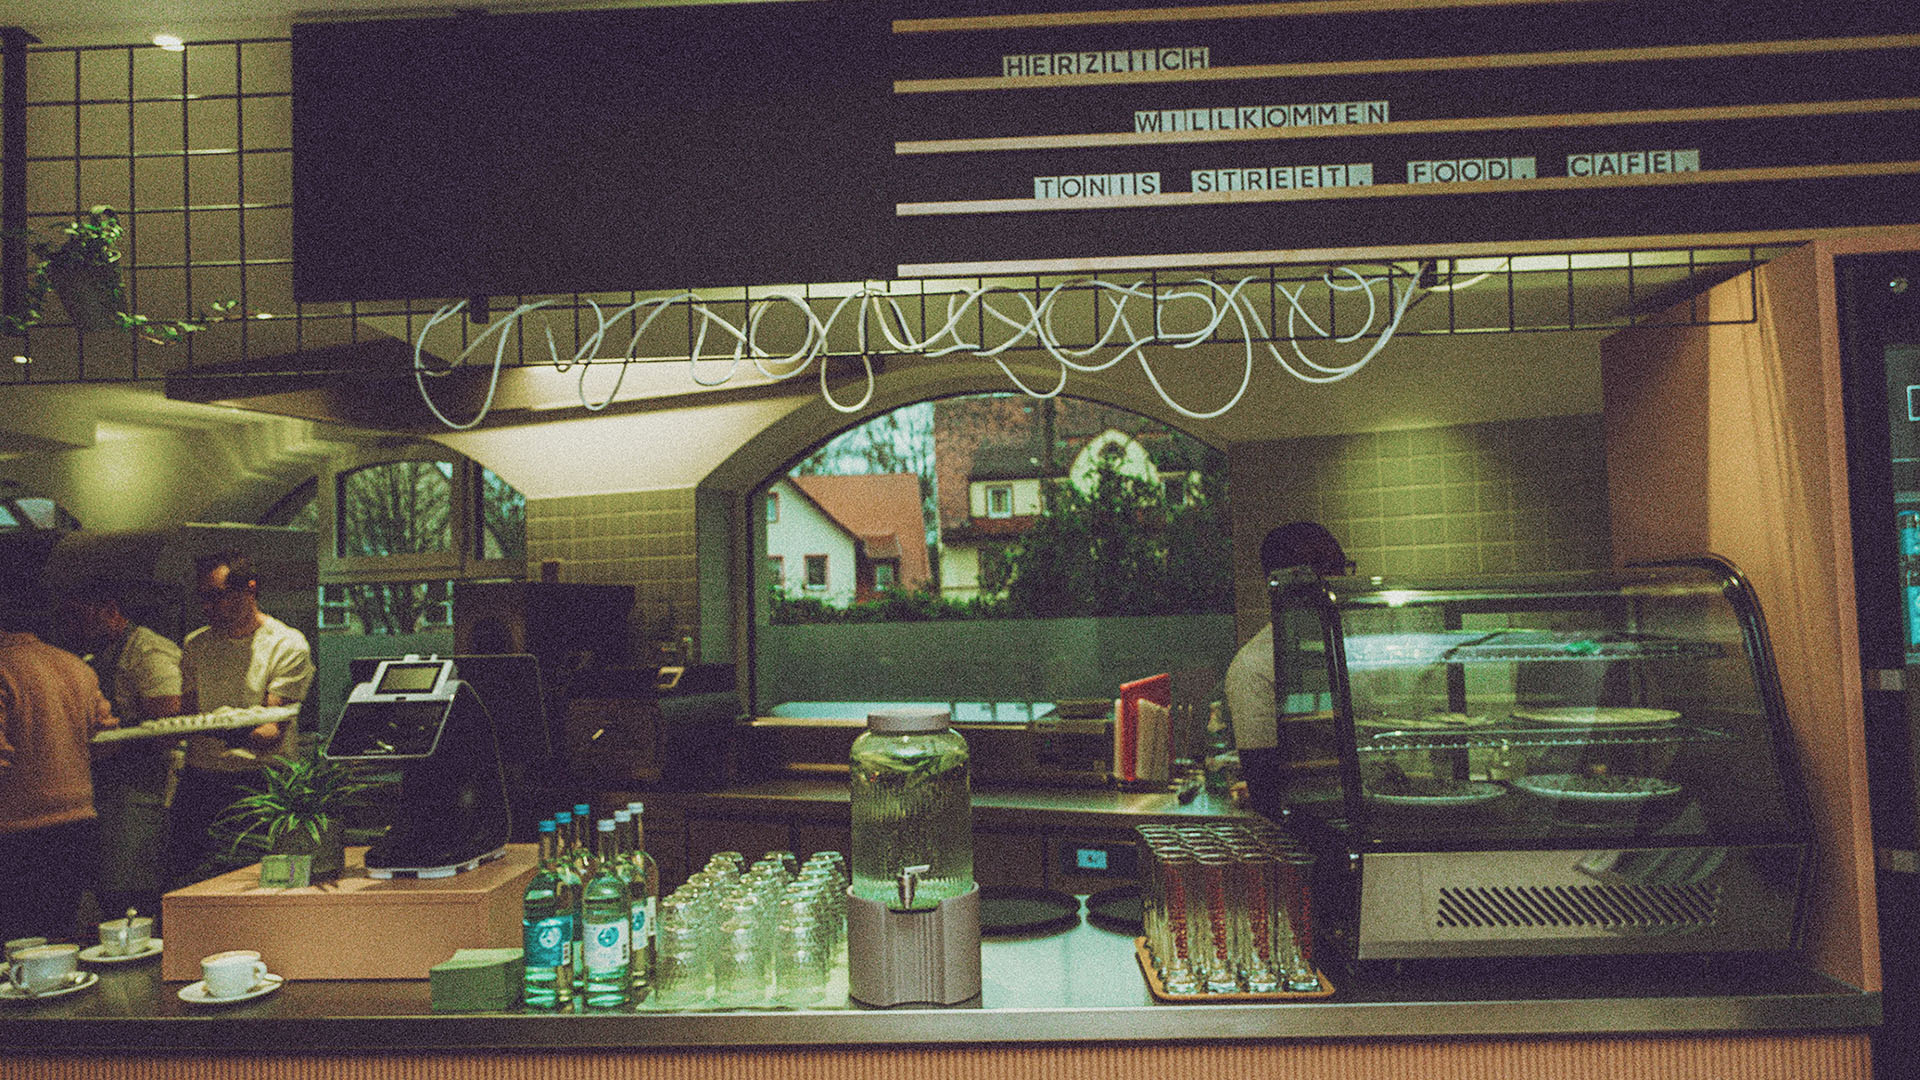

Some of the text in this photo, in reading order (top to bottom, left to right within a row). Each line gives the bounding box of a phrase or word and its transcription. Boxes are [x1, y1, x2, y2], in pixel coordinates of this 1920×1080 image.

[1006, 49, 1207, 77] HERZLICH
[1136, 104, 1386, 133] WILLKOMMEN
[1039, 151, 1692, 199] TONIS STREET. FOOD. CAFE.
